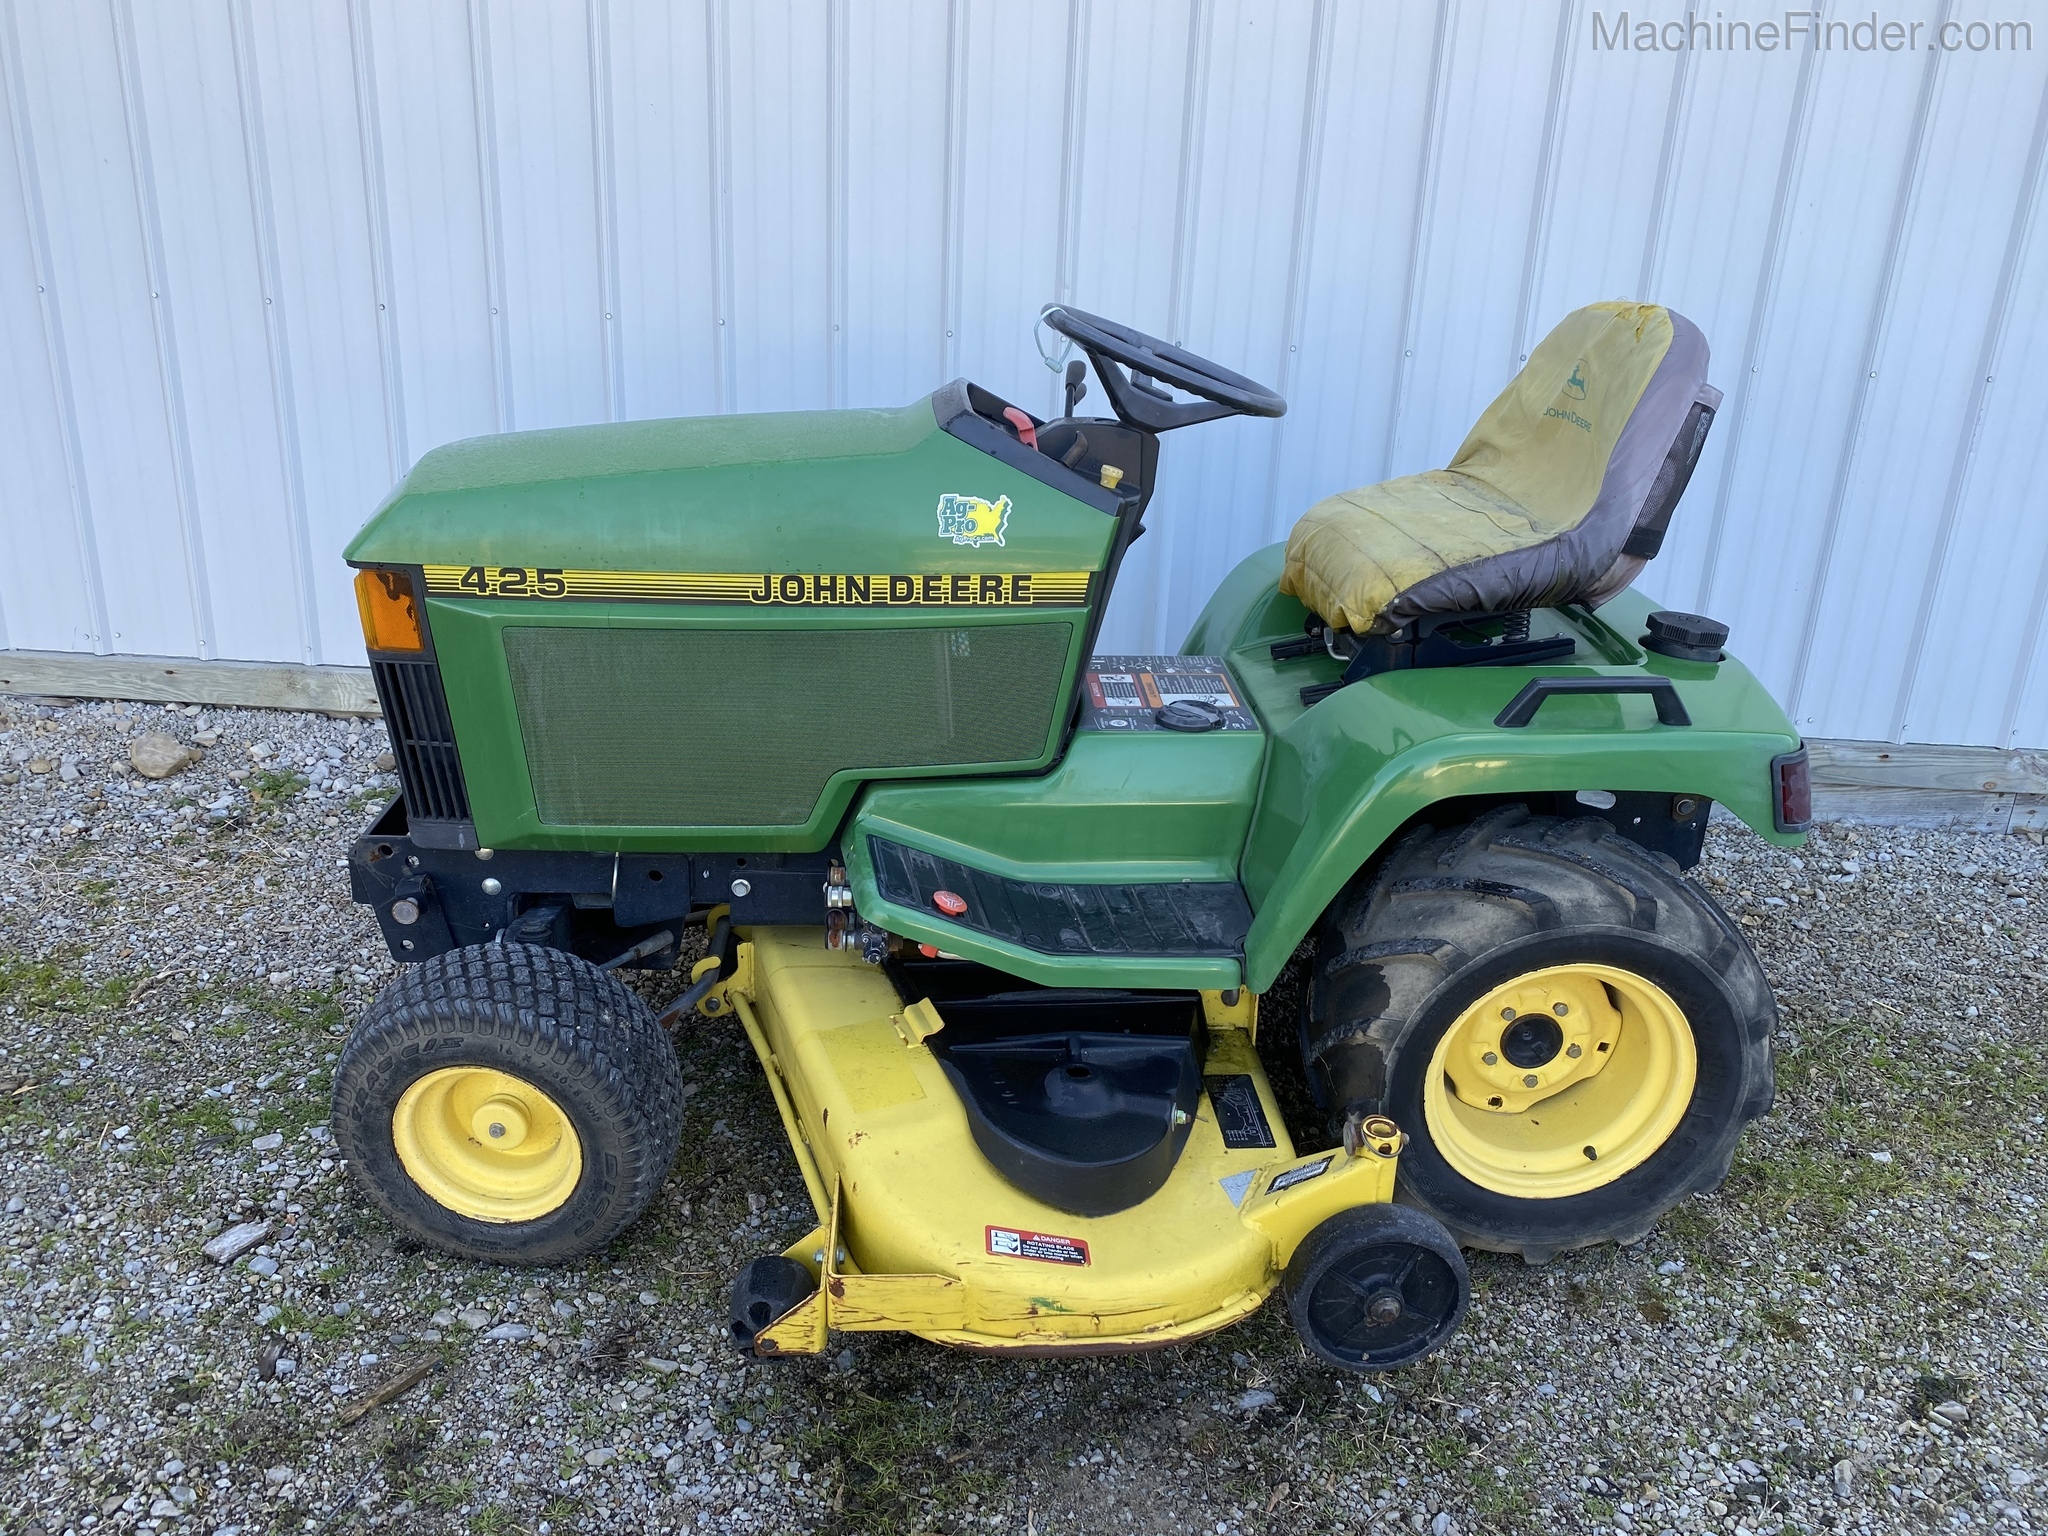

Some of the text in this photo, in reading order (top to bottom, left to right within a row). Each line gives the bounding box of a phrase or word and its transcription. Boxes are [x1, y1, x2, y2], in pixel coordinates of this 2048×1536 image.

[1543, 405, 1592, 433] JOHN DEERE
[941, 497, 975, 518] Ag-
[941, 515, 976, 534] Pro
[459, 566, 567, 598] 425
[750, 574, 1033, 605] JOHN DEERE
[1026, 1240, 1055, 1249] ROTATING
[1040, 1235, 1071, 1245] DANGER
